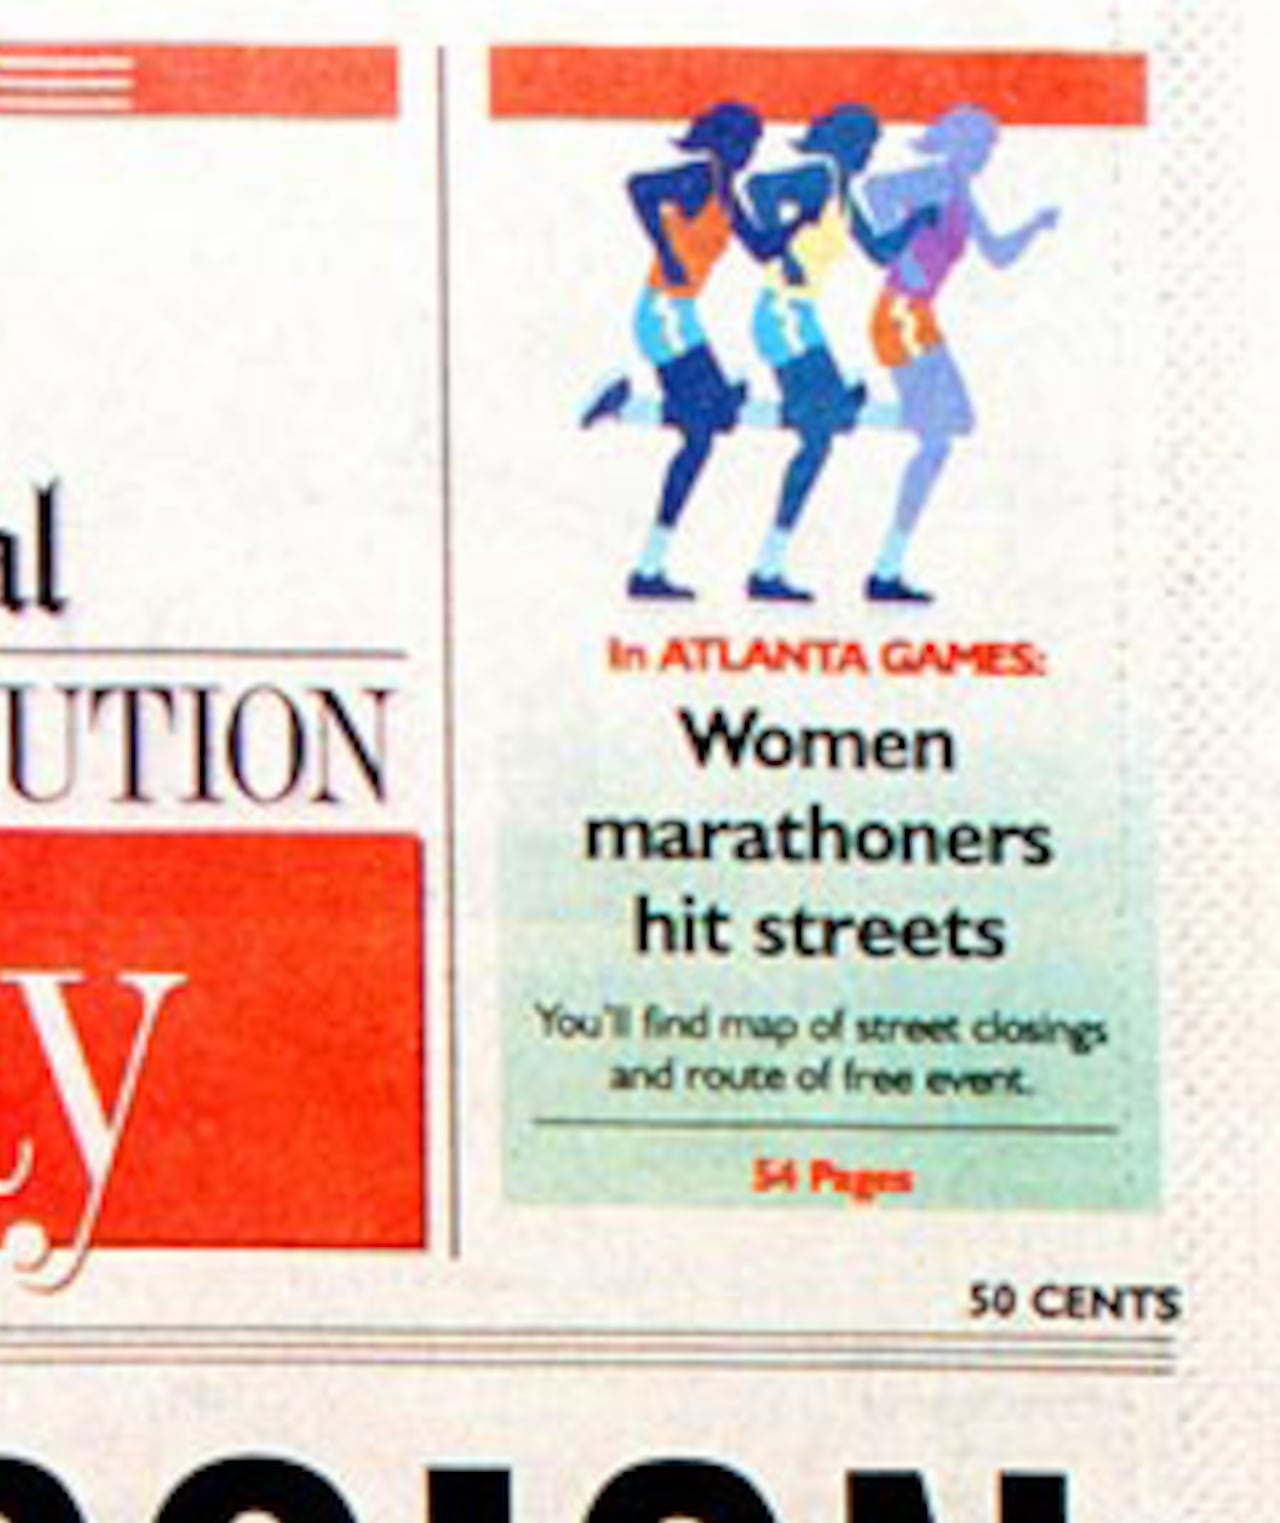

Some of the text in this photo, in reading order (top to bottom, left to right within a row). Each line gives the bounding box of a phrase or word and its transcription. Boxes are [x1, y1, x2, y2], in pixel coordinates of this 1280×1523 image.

[610, 638, 1044, 676] In ATLANTA GAMES:
[679, 708, 954, 770] Women
[587, 803, 1052, 866] marathoners
[637, 895, 1005, 958] hit streets
[536, 1003, 1108, 1056] You'll find map of street closings
[611, 1060, 1034, 1096] and route of free event.
[754, 1158, 912, 1203] 54 Pages
[971, 1282, 1181, 1323] 50 CENTS
